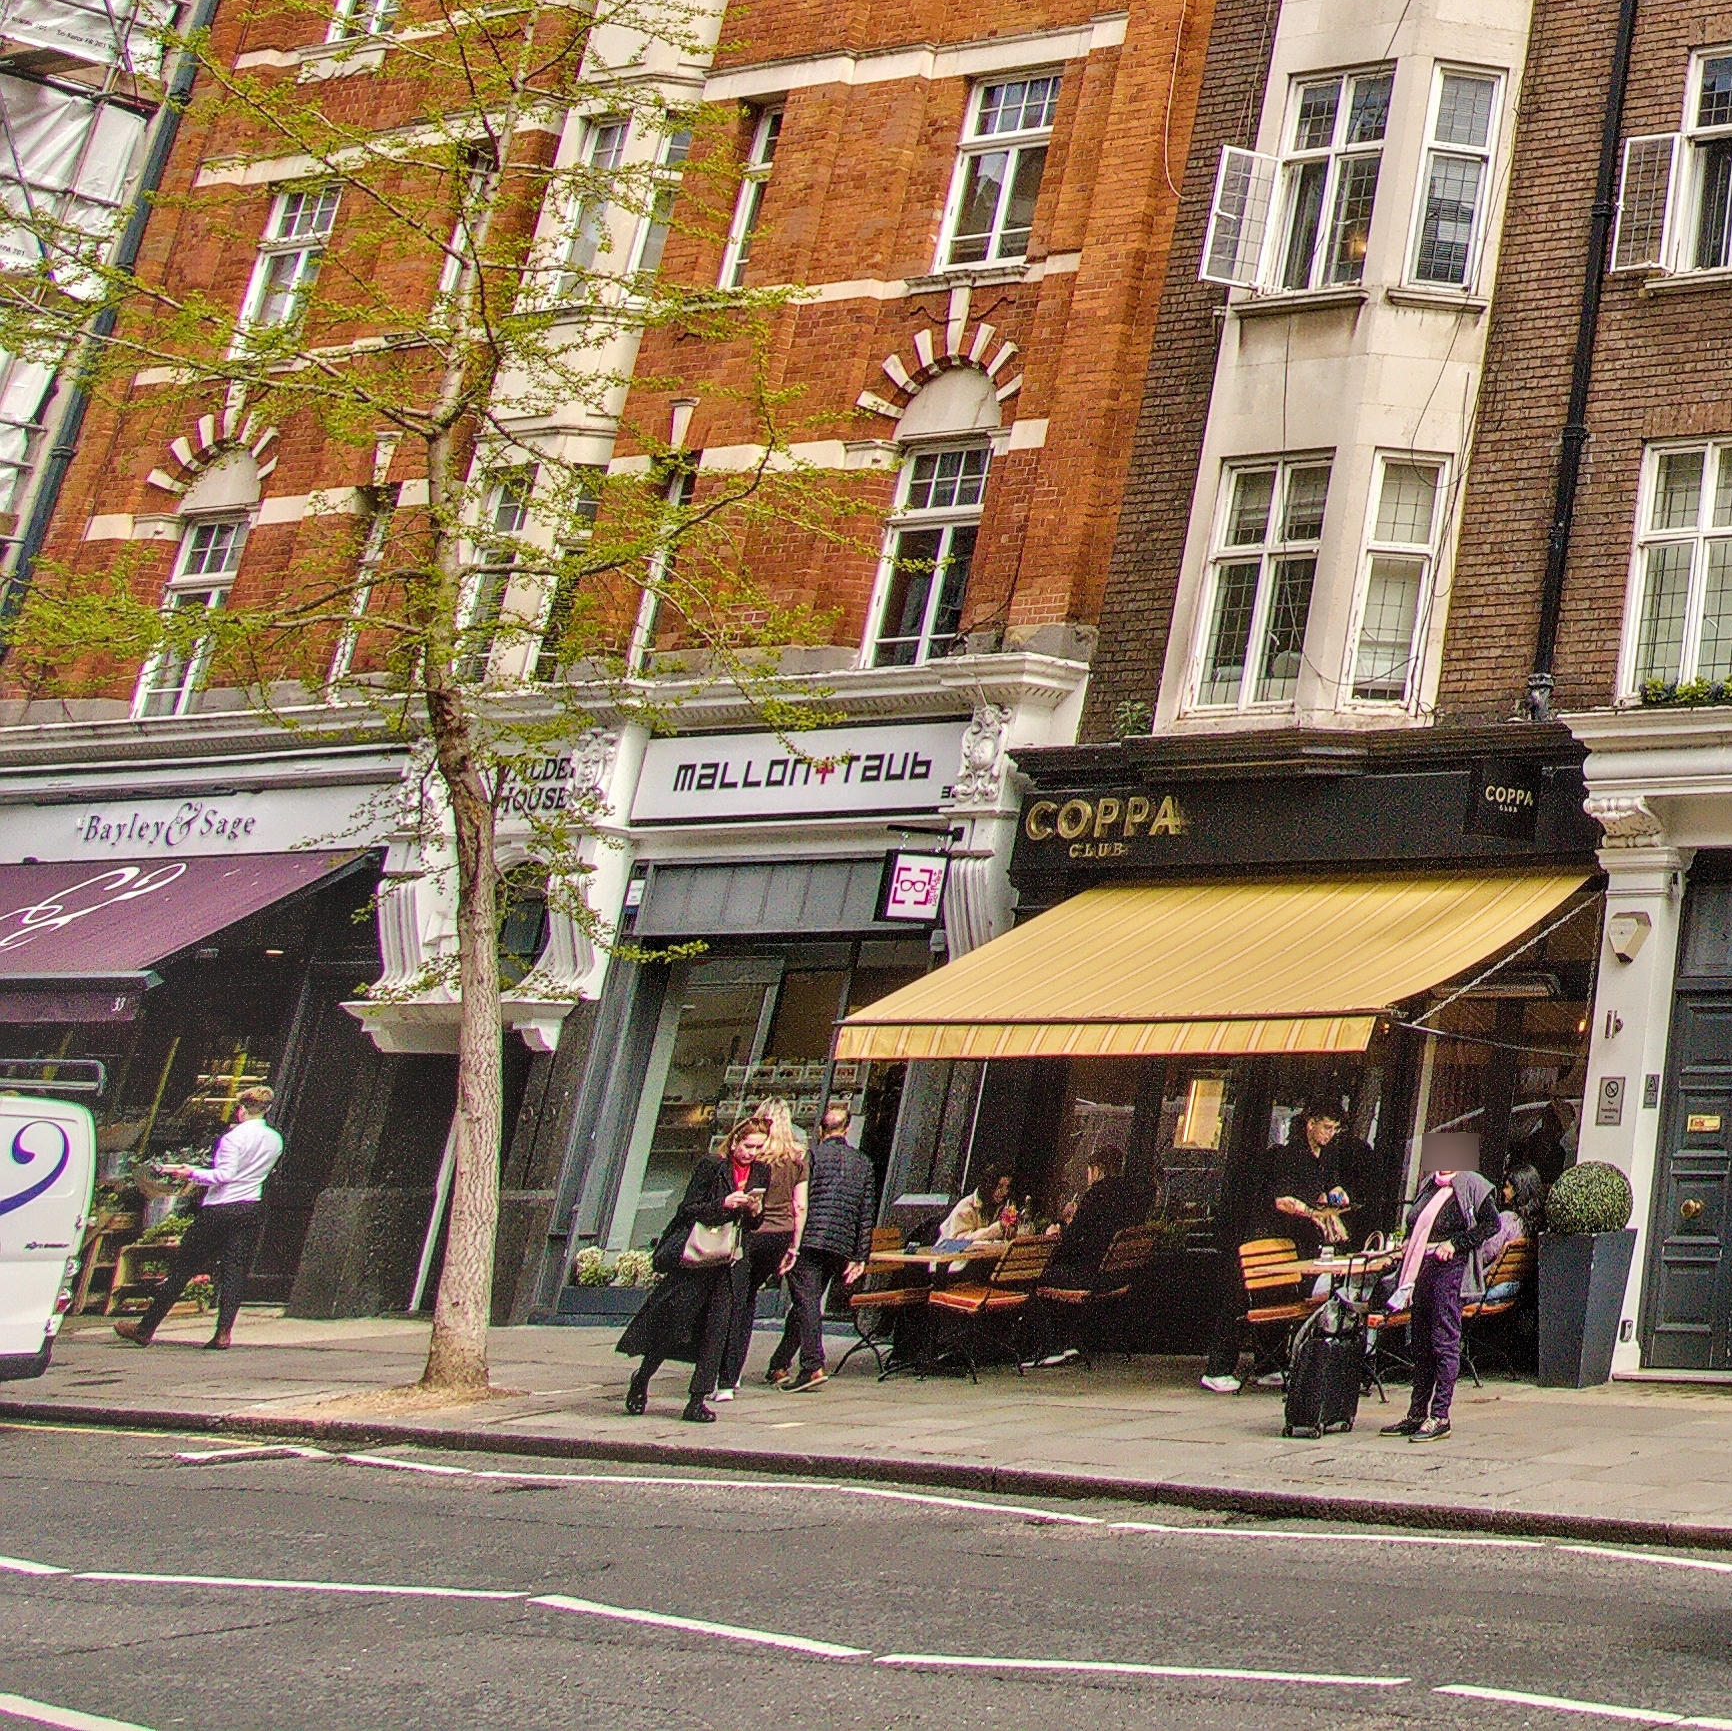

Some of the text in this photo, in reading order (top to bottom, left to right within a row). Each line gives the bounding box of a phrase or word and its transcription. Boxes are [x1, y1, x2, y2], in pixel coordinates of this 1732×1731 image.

[1485, 785, 1534, 806] COPPA
[84, 801, 256, 847] Bayley & Sage
[1026, 796, 1183, 841] COPPA
[1069, 842, 1127, 858] CLUB
